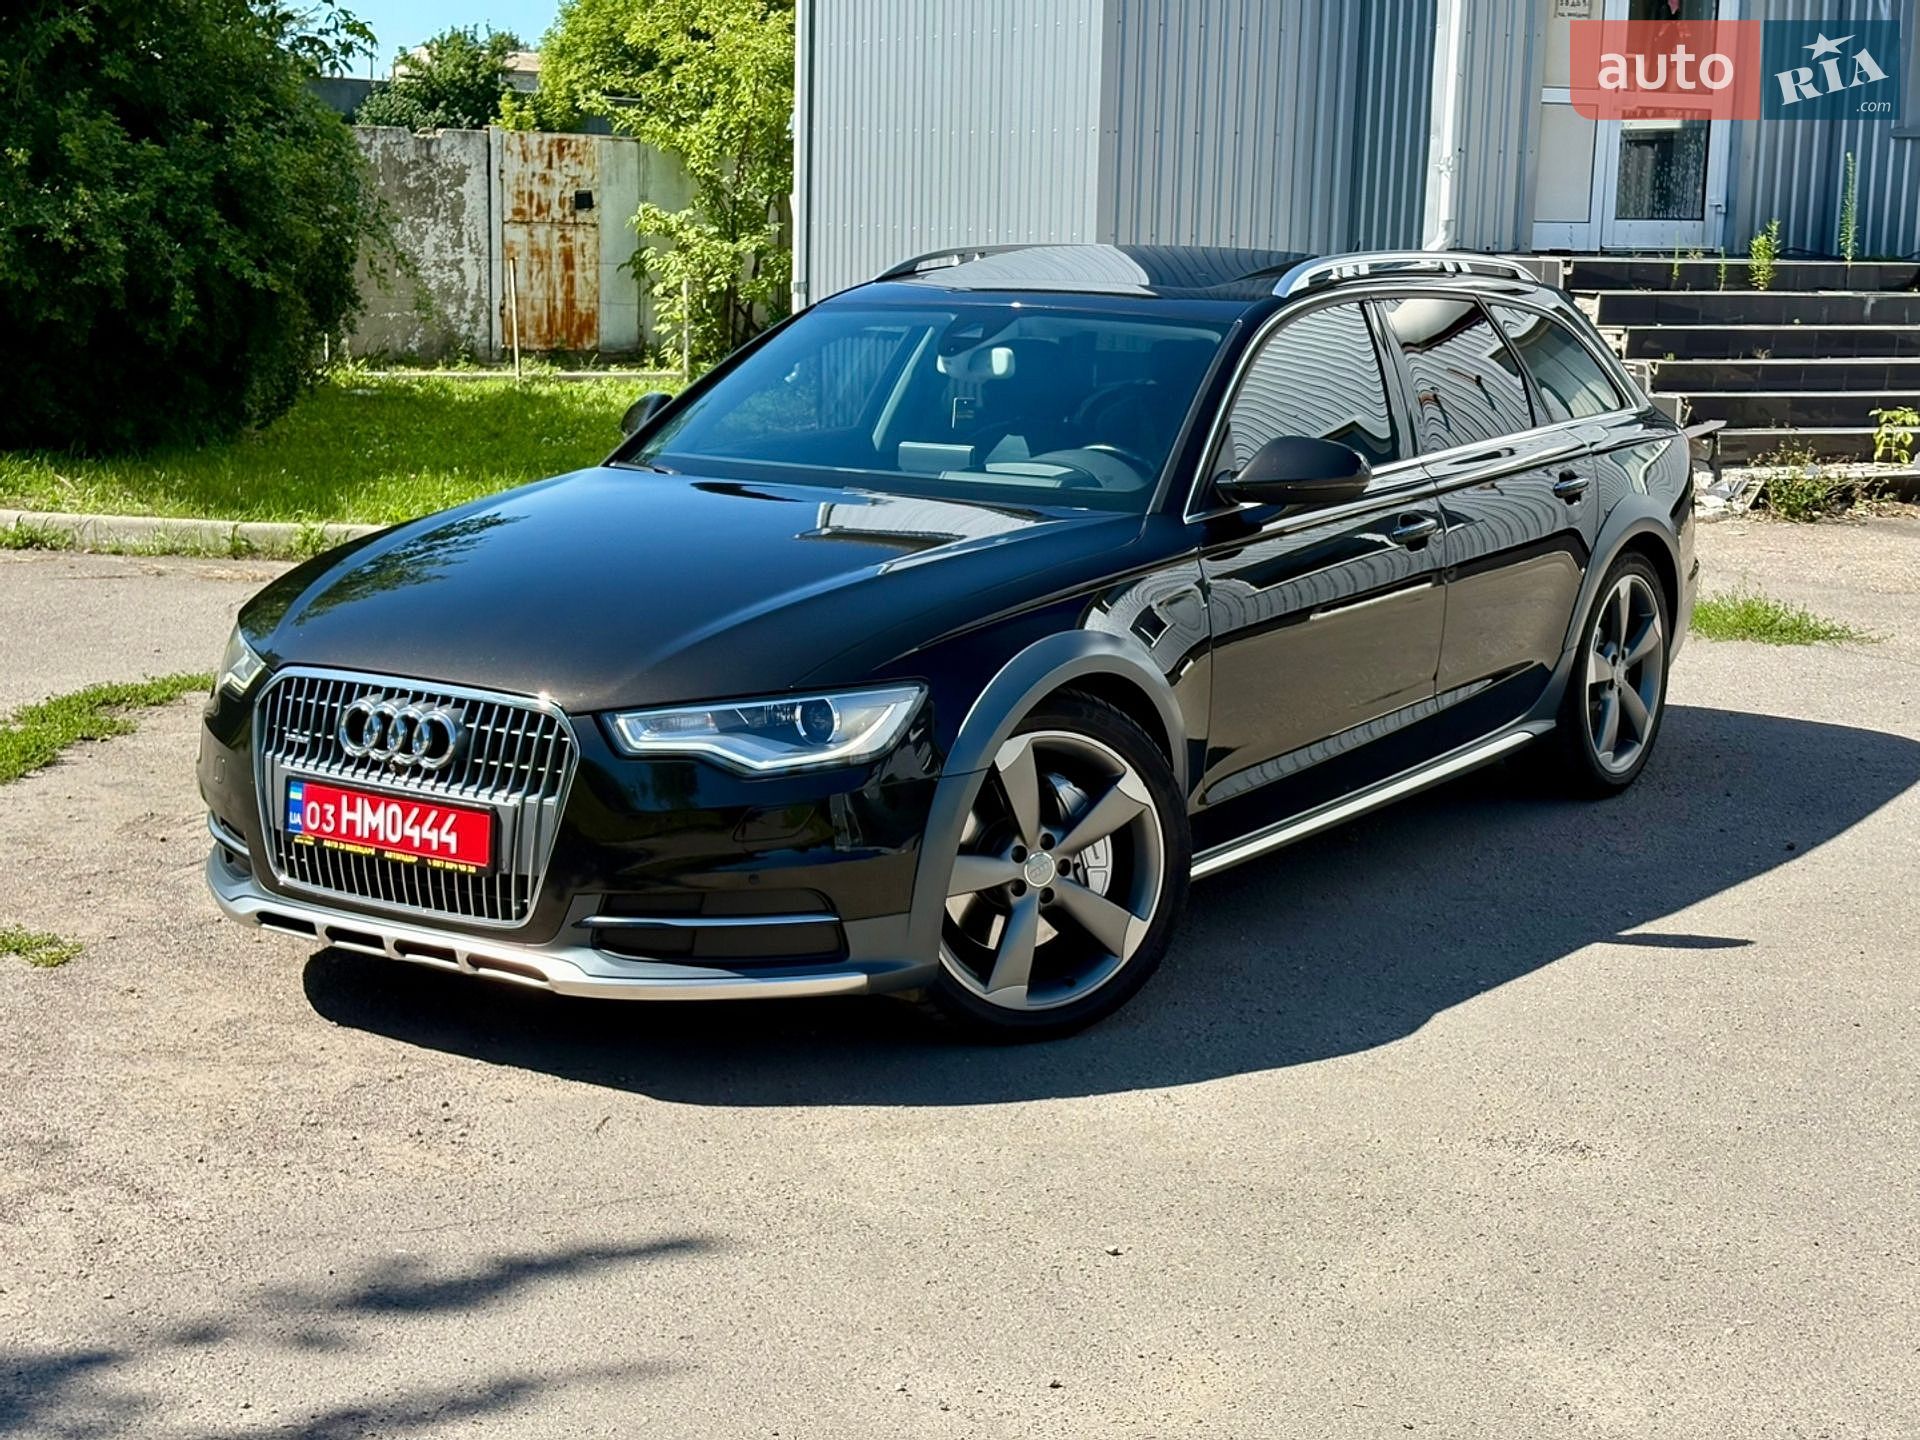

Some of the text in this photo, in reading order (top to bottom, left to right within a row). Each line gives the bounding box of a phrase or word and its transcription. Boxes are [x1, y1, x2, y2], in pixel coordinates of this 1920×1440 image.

[289, 812, 302, 825] UA
[306, 794, 457, 854] 03 HM0444
